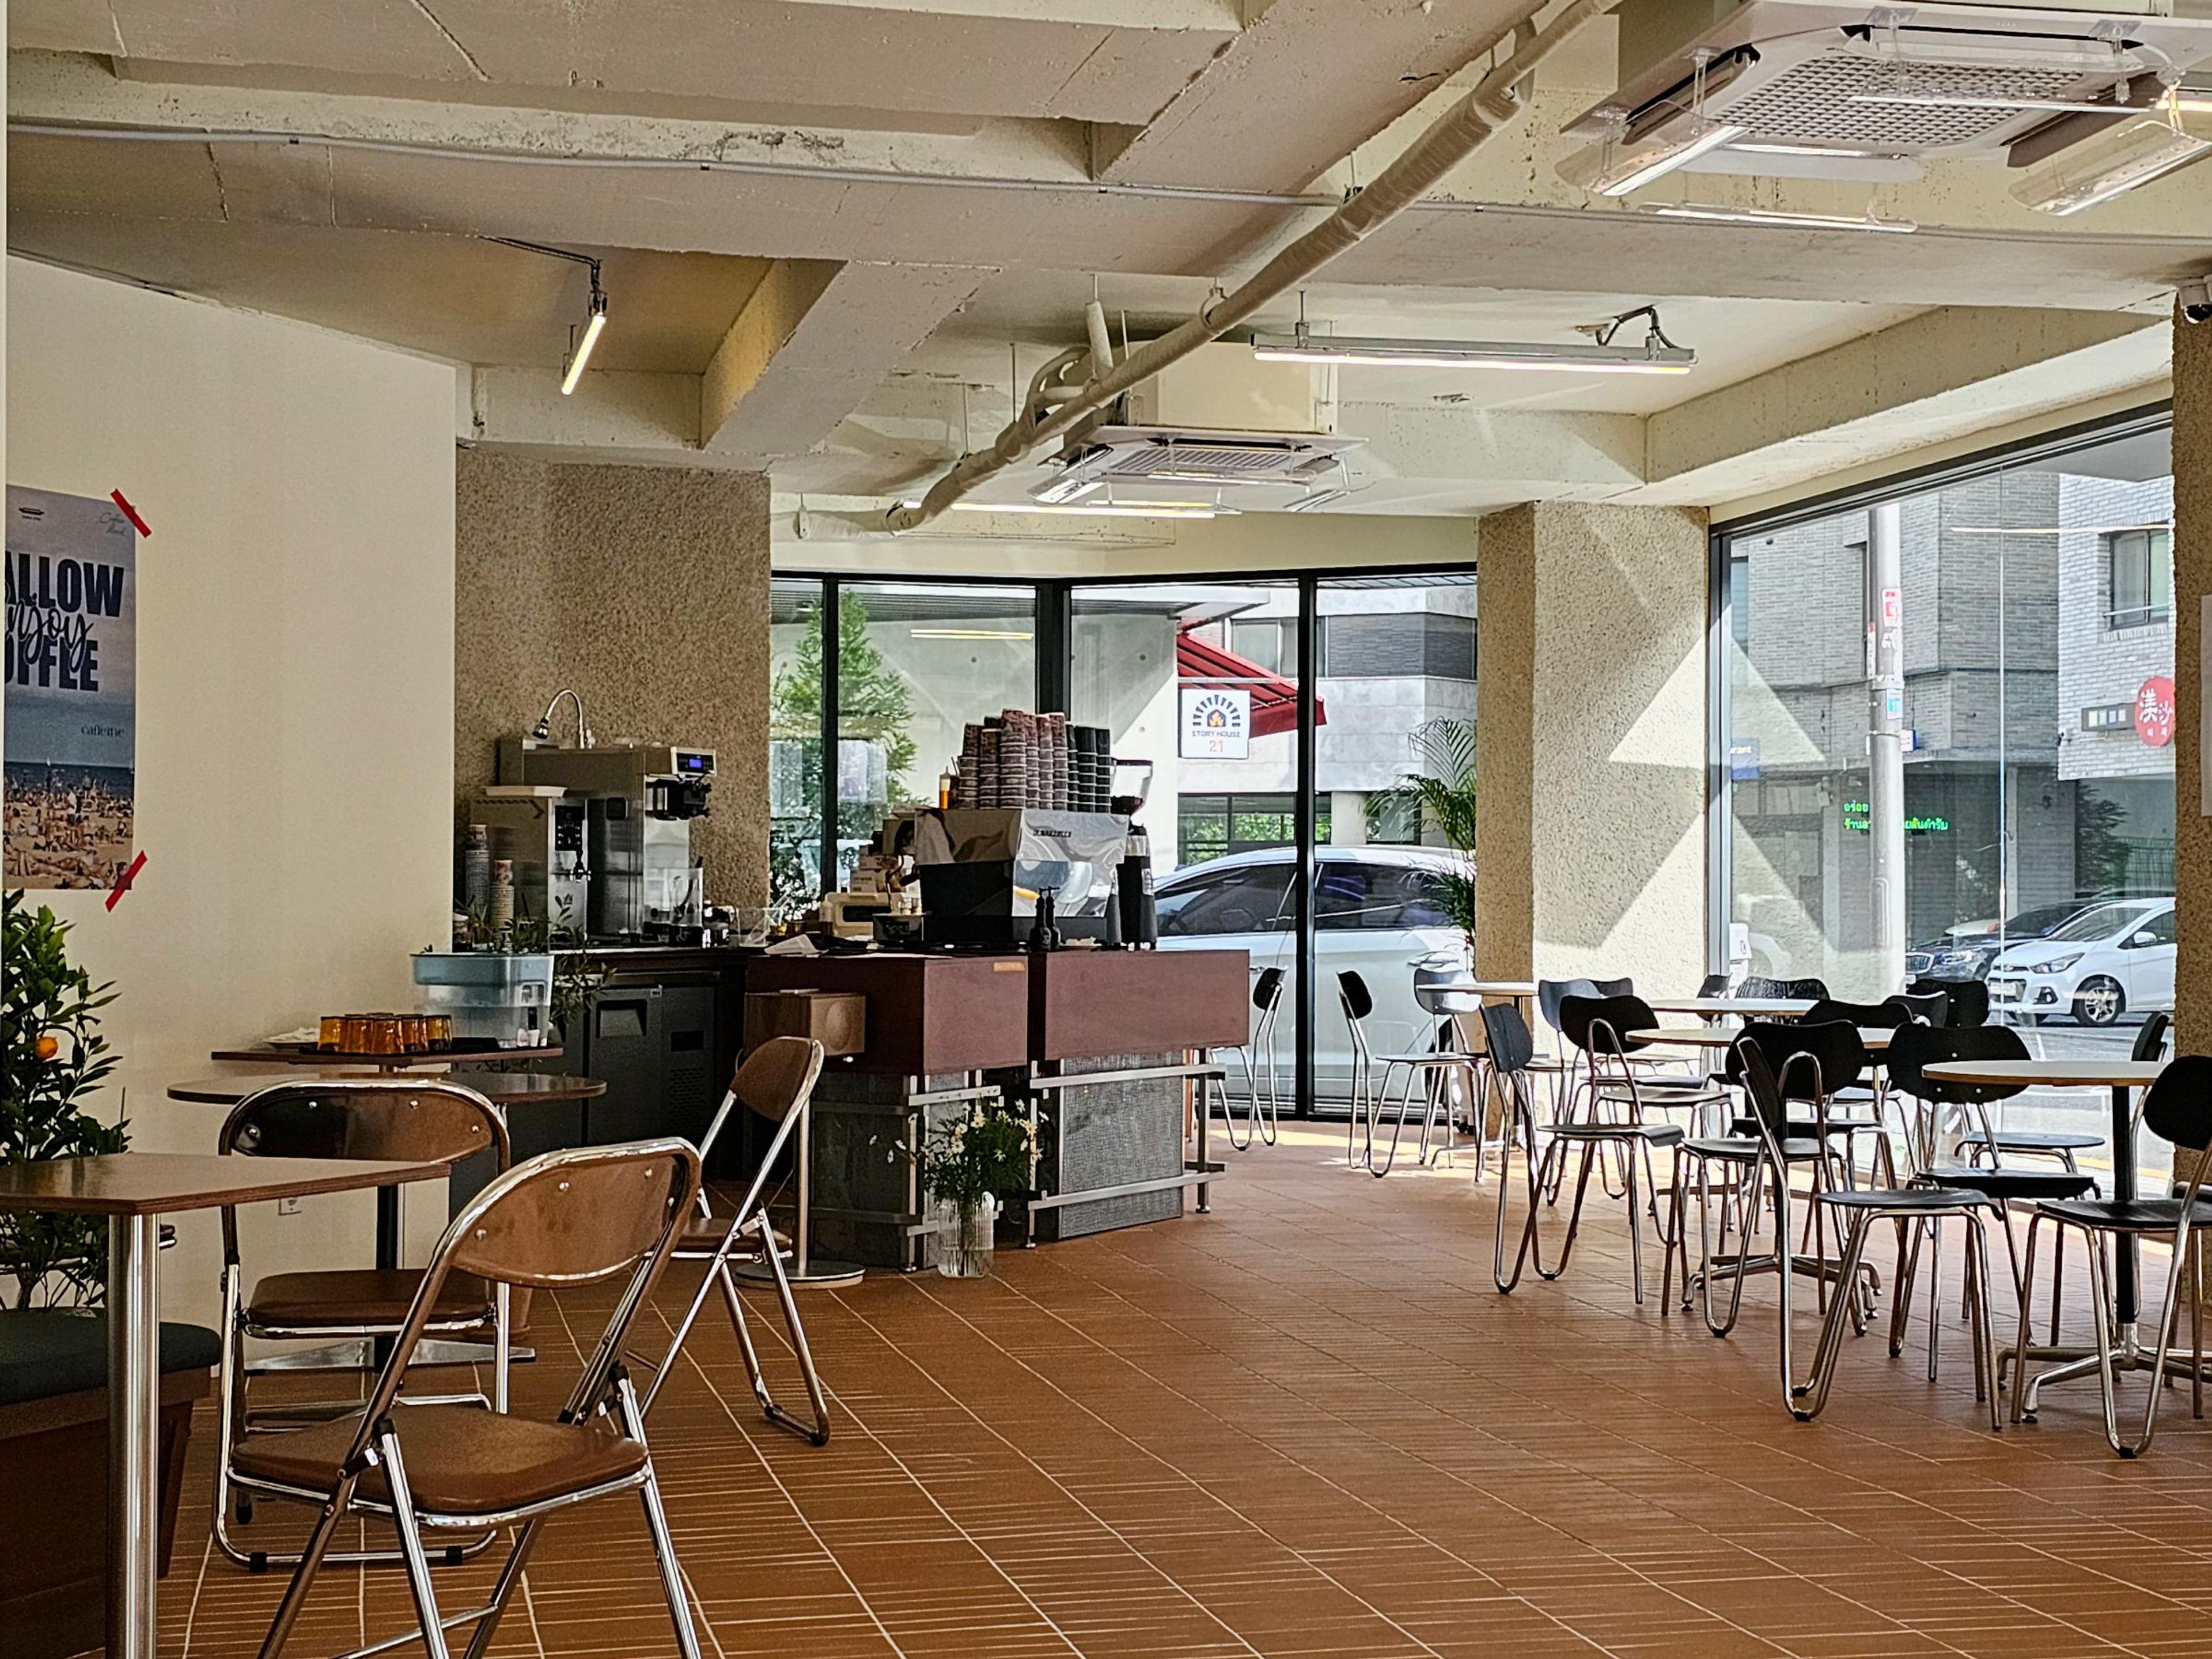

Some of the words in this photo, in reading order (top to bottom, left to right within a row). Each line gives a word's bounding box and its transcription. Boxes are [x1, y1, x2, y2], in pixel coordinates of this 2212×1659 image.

[6, 589, 94, 673] njoy
[81, 724, 124, 738] caffeine
[1209, 740, 1224, 752] 21
